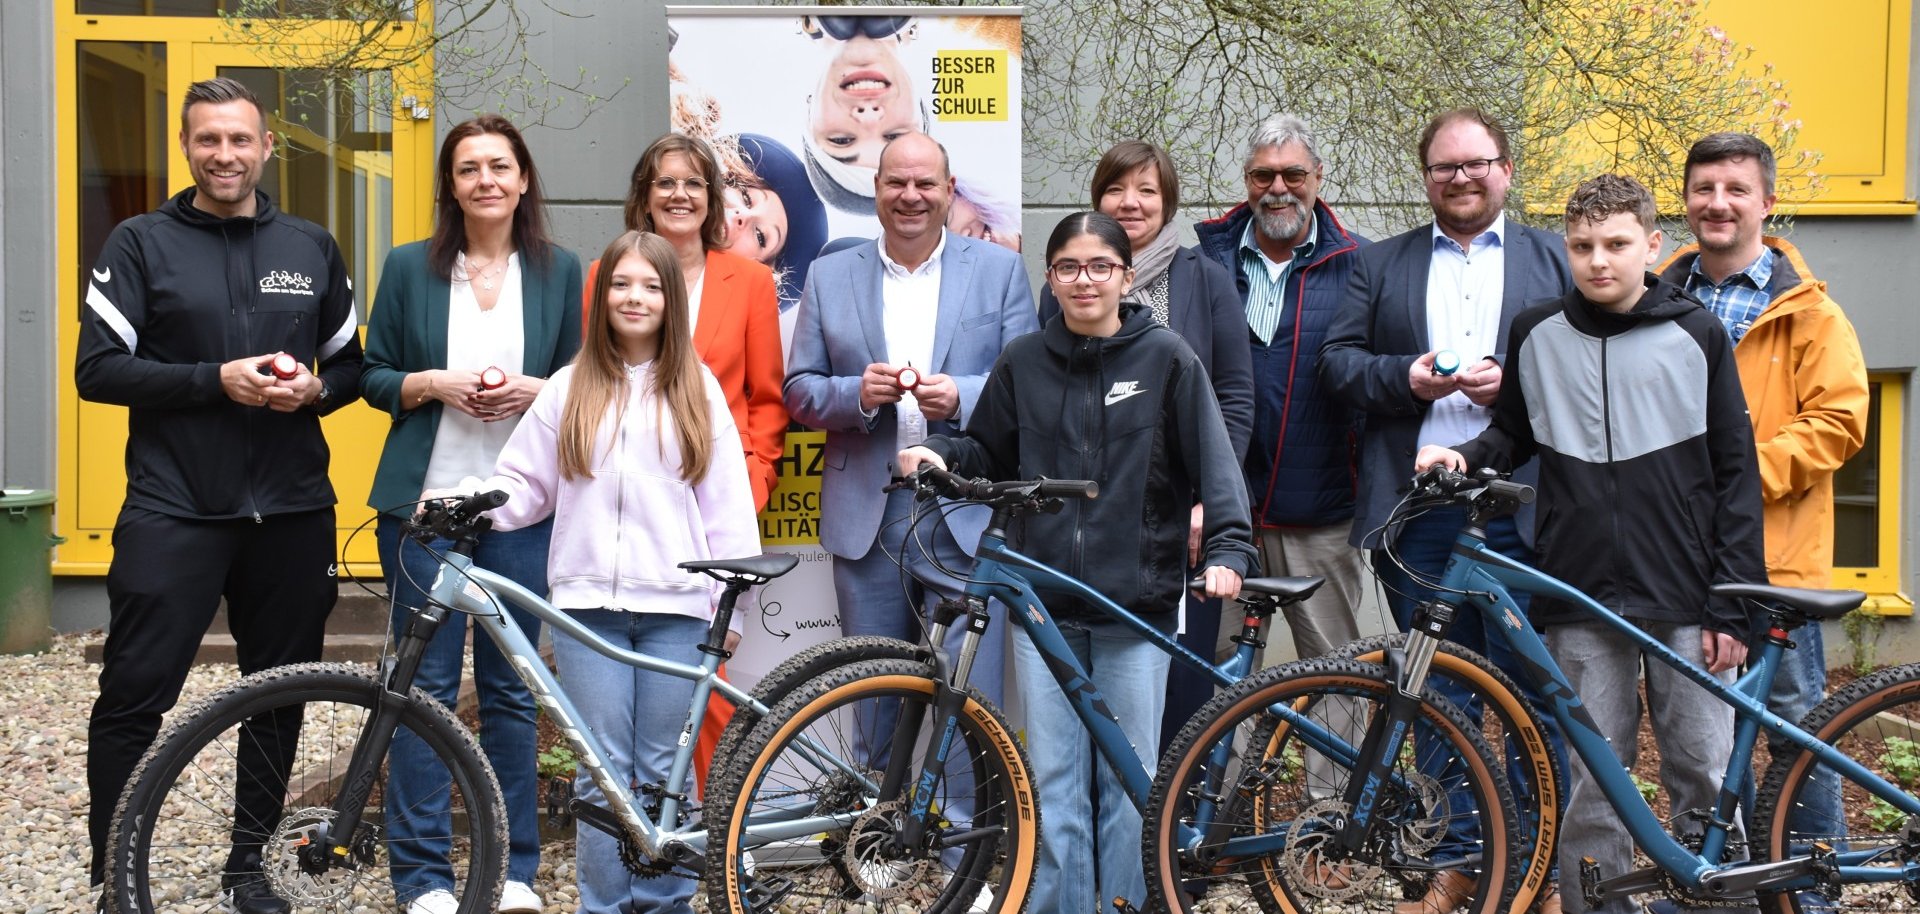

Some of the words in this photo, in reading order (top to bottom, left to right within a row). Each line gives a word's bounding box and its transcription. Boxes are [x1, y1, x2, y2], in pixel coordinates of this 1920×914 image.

[932, 57, 995, 74] BESSER
[931, 77, 964, 94] ZUR
[932, 97, 996, 115] SCHULE
[1110, 381, 1139, 395] NIKE
[972, 708, 1031, 821] SCHWALBE
[1536, 760, 1553, 808] SAM
[126, 814, 144, 909] KENDA
[1526, 816, 1553, 892] SMART
